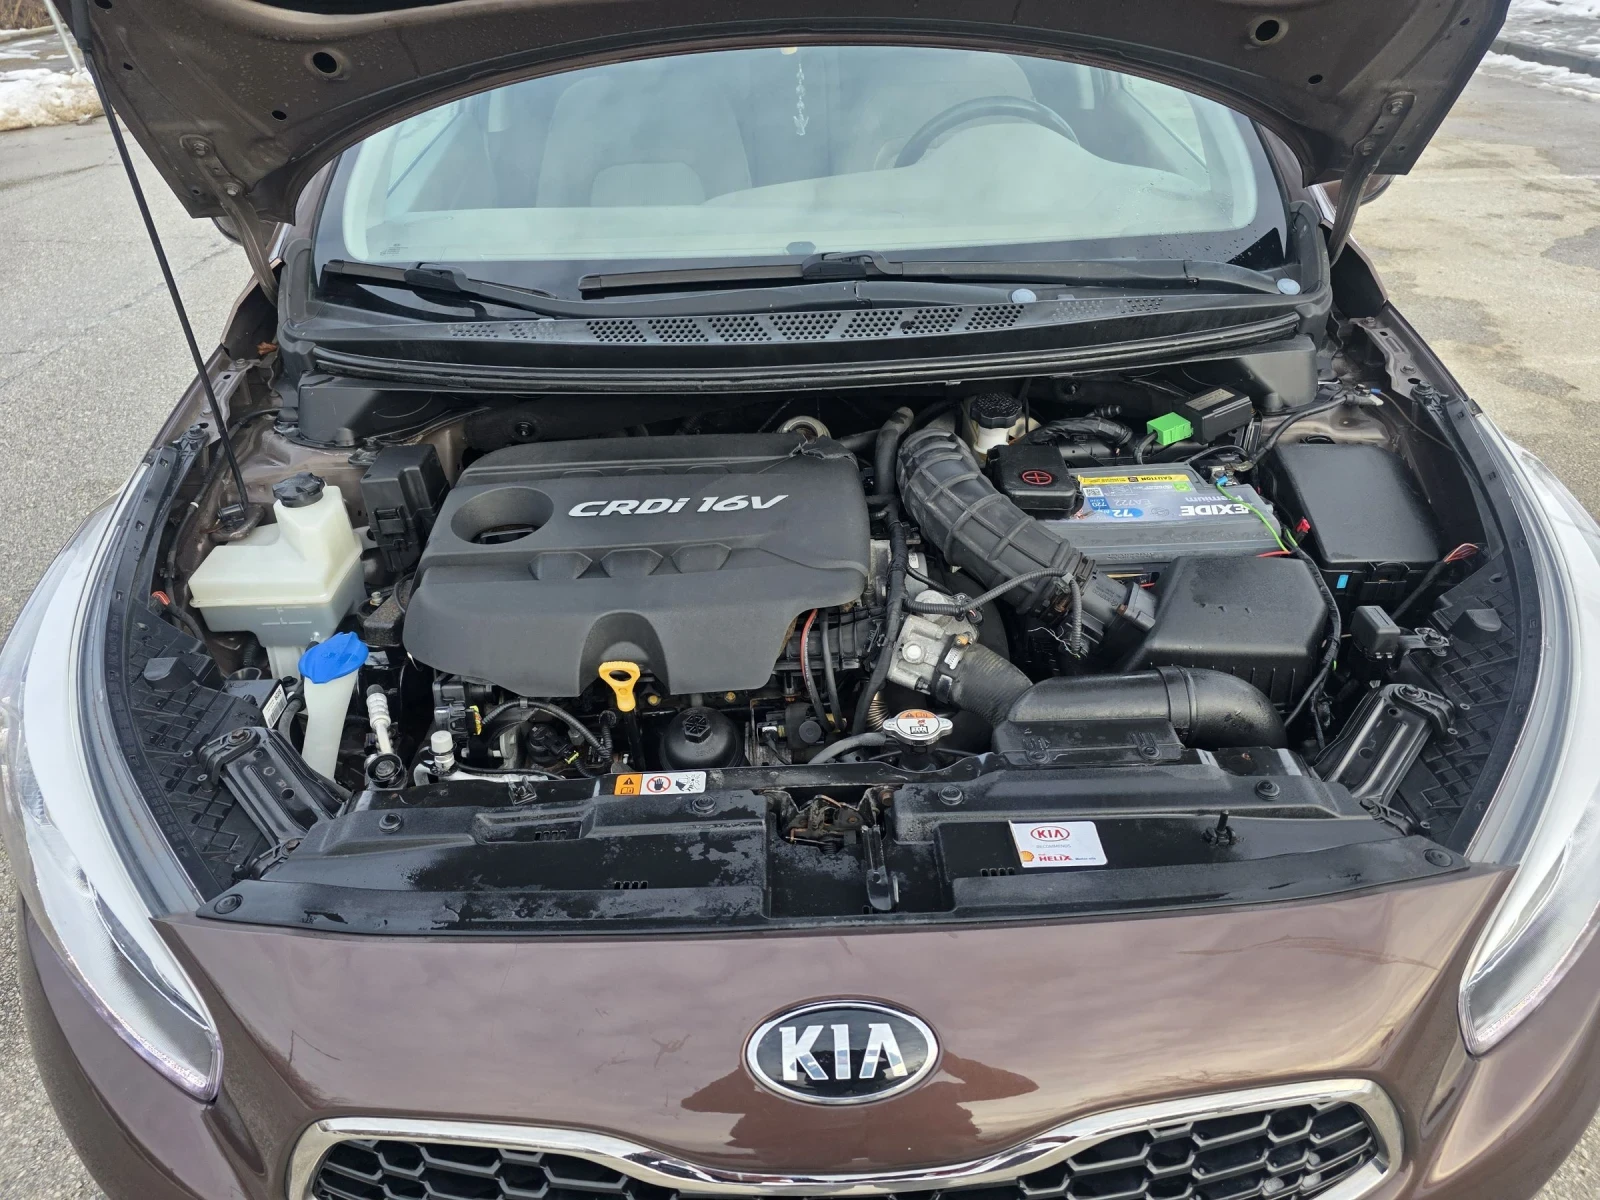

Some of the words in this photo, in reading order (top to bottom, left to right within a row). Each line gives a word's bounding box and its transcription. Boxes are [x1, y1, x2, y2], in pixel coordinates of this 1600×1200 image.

[568, 497, 691, 517] CRDi
[697, 494, 789, 513] 16V
[1179, 503, 1250, 517] EXIDE
[1111, 509, 1134, 518] 72
[1037, 829, 1064, 838] KIA
[779, 1023, 909, 1081] KIA
